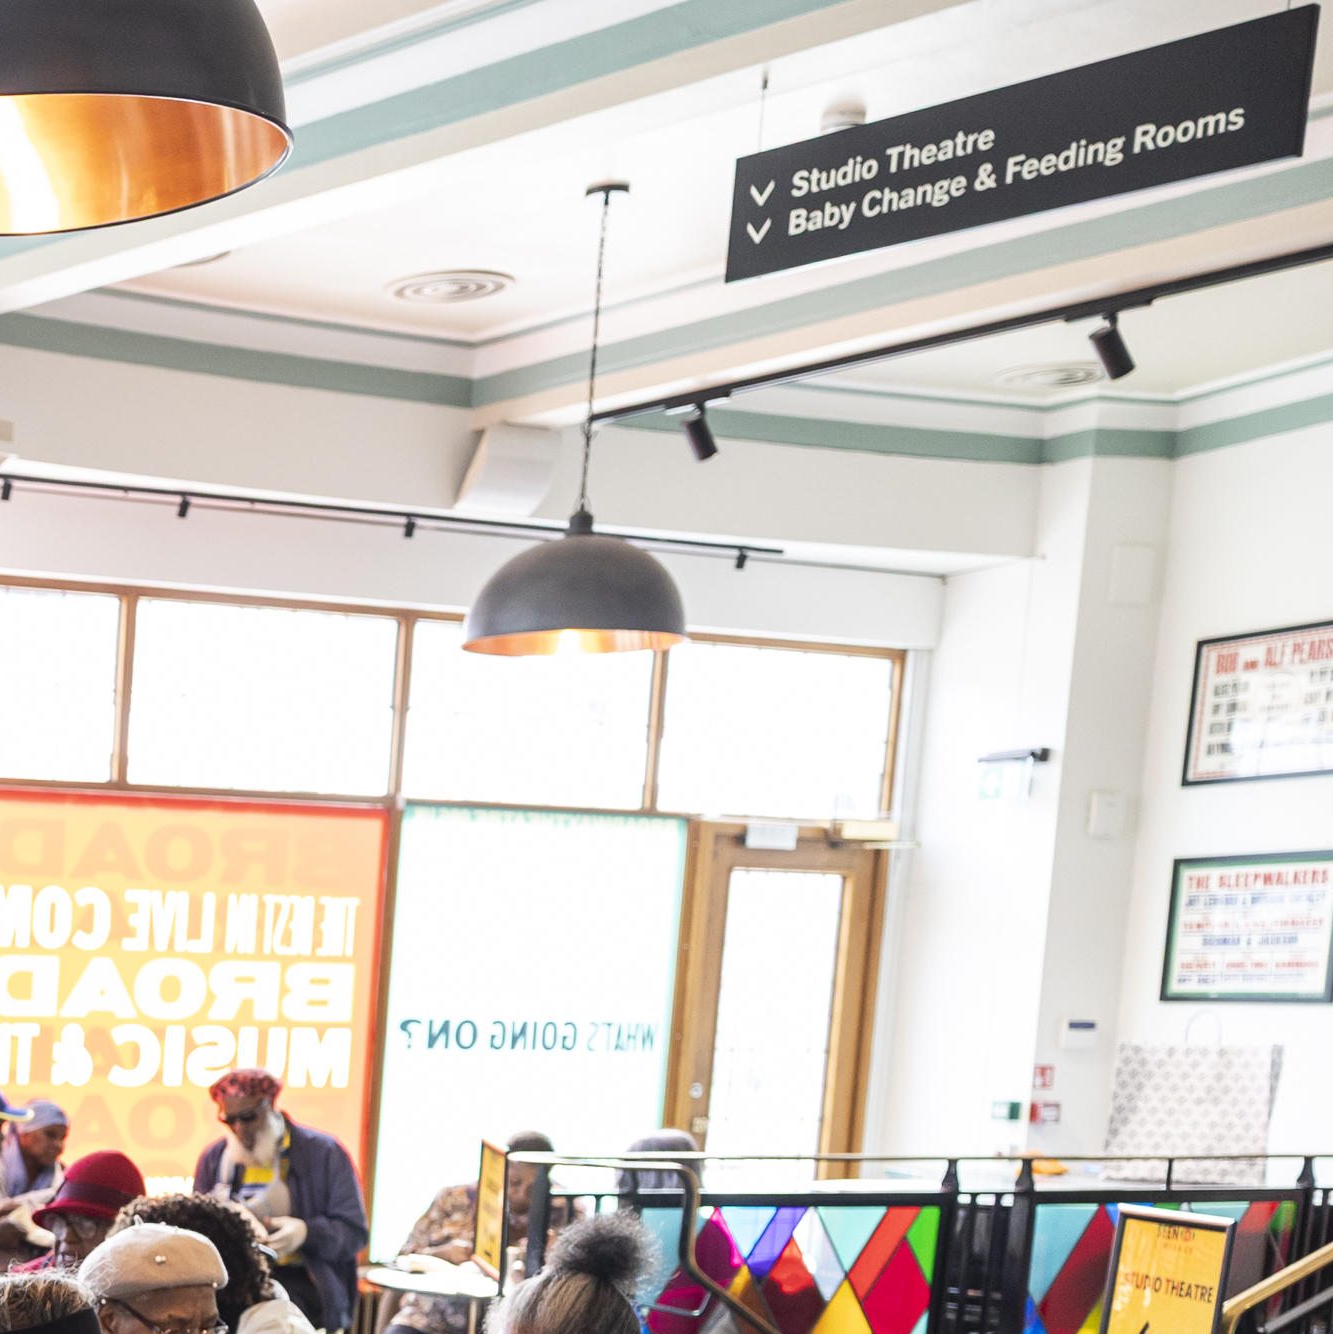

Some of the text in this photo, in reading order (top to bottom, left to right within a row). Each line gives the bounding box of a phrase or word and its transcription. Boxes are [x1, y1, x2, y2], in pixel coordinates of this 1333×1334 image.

[787, 106, 1245, 237] Baby Change & Feeding Rooms
[790, 127, 995, 198] Studio Theatre
[1125, 1272, 1213, 1303] STUDIO THEATRE
